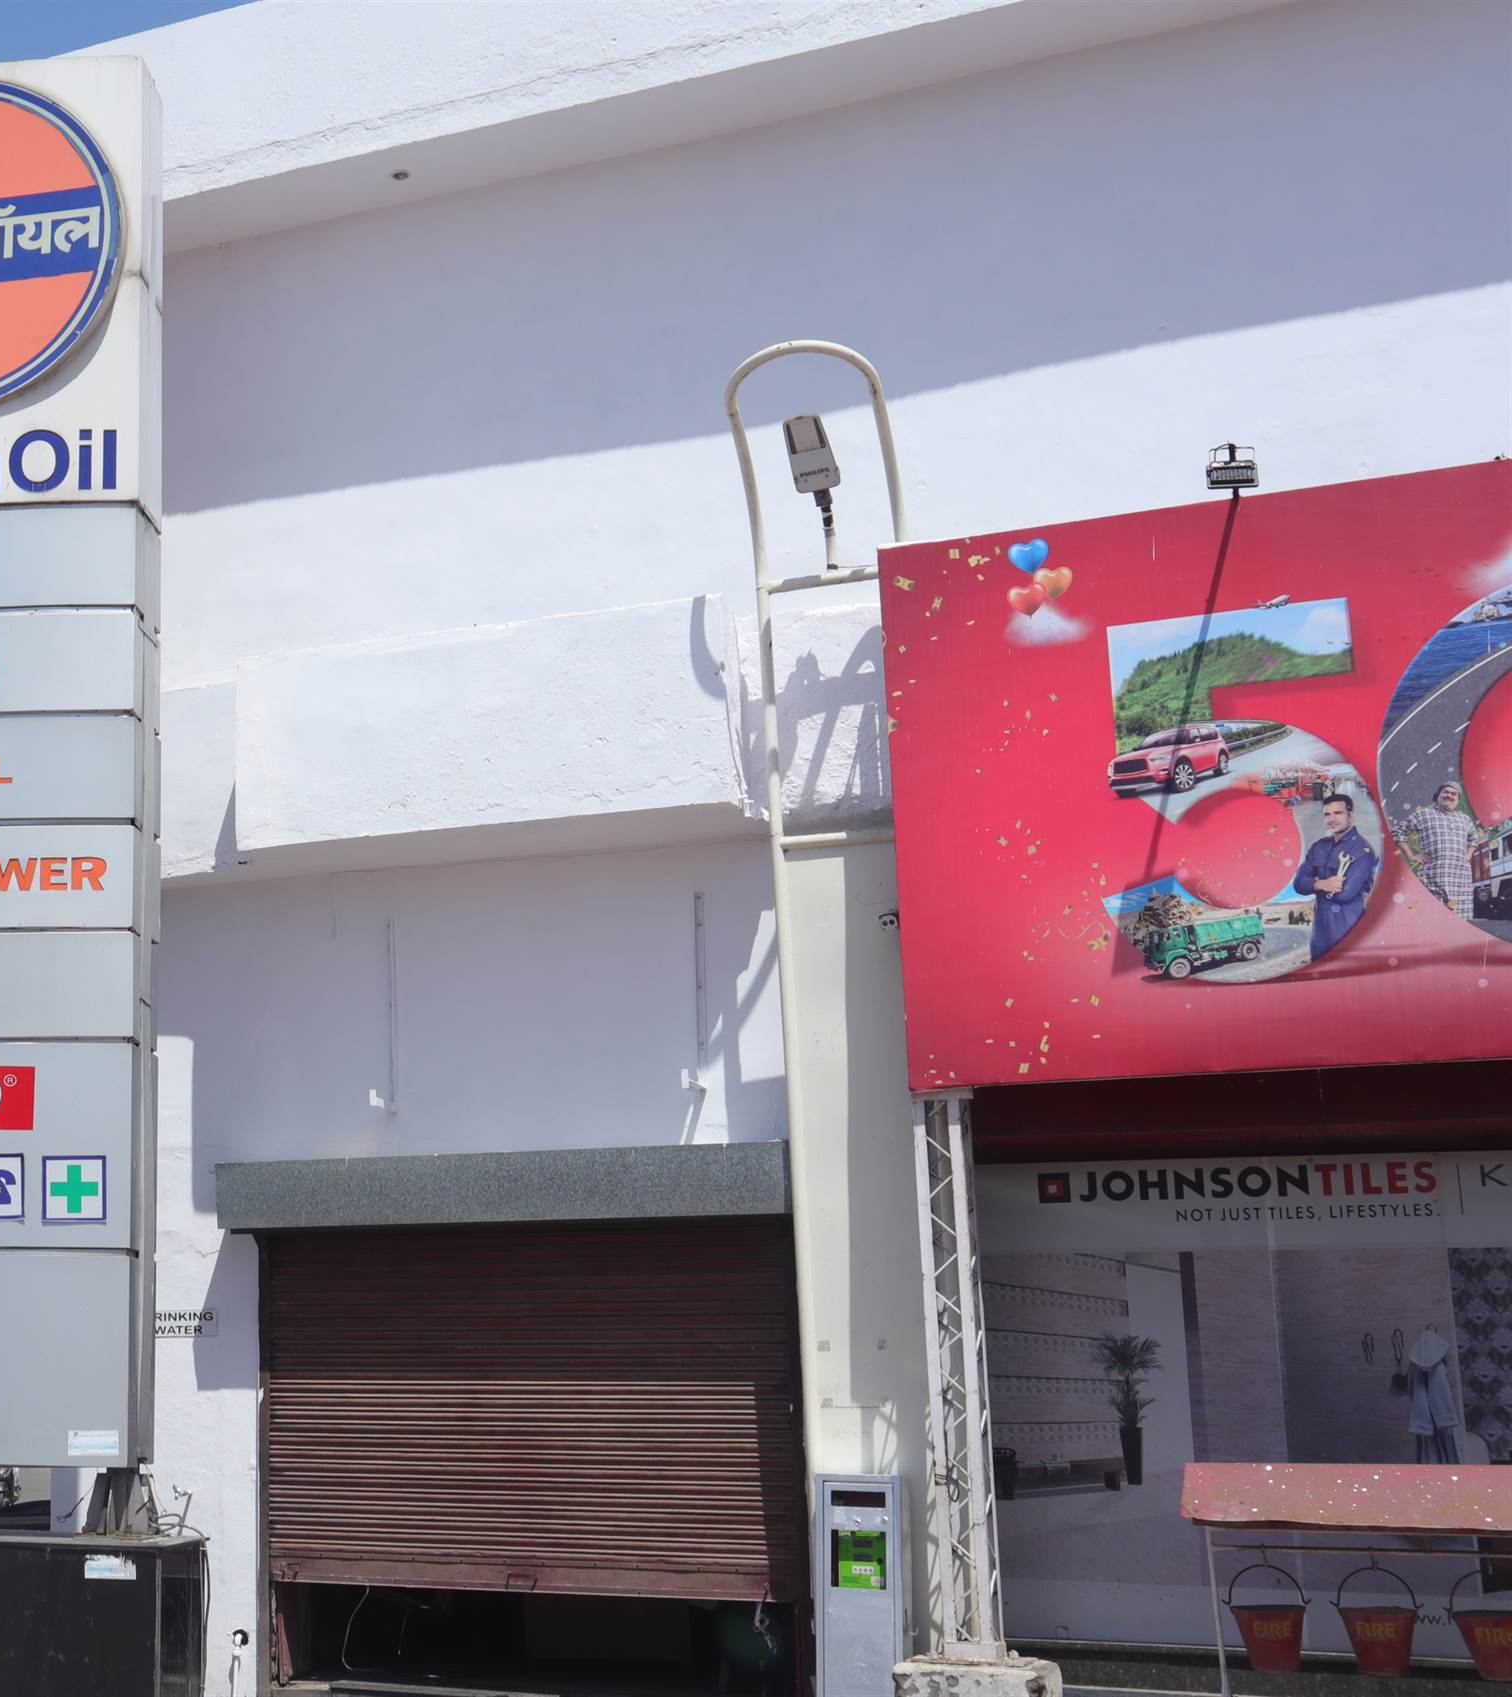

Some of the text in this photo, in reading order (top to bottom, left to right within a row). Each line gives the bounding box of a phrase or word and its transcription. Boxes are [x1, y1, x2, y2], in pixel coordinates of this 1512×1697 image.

[1176, 1202, 1440, 1223] NOT JUST TILES, LIFESTYLES.
[155, 1312, 214, 1322] RINKING
[155, 1325, 203, 1335] WATER
[1253, 1620, 1292, 1640] FIRE
[1356, 1620, 1396, 1640] FIRE
